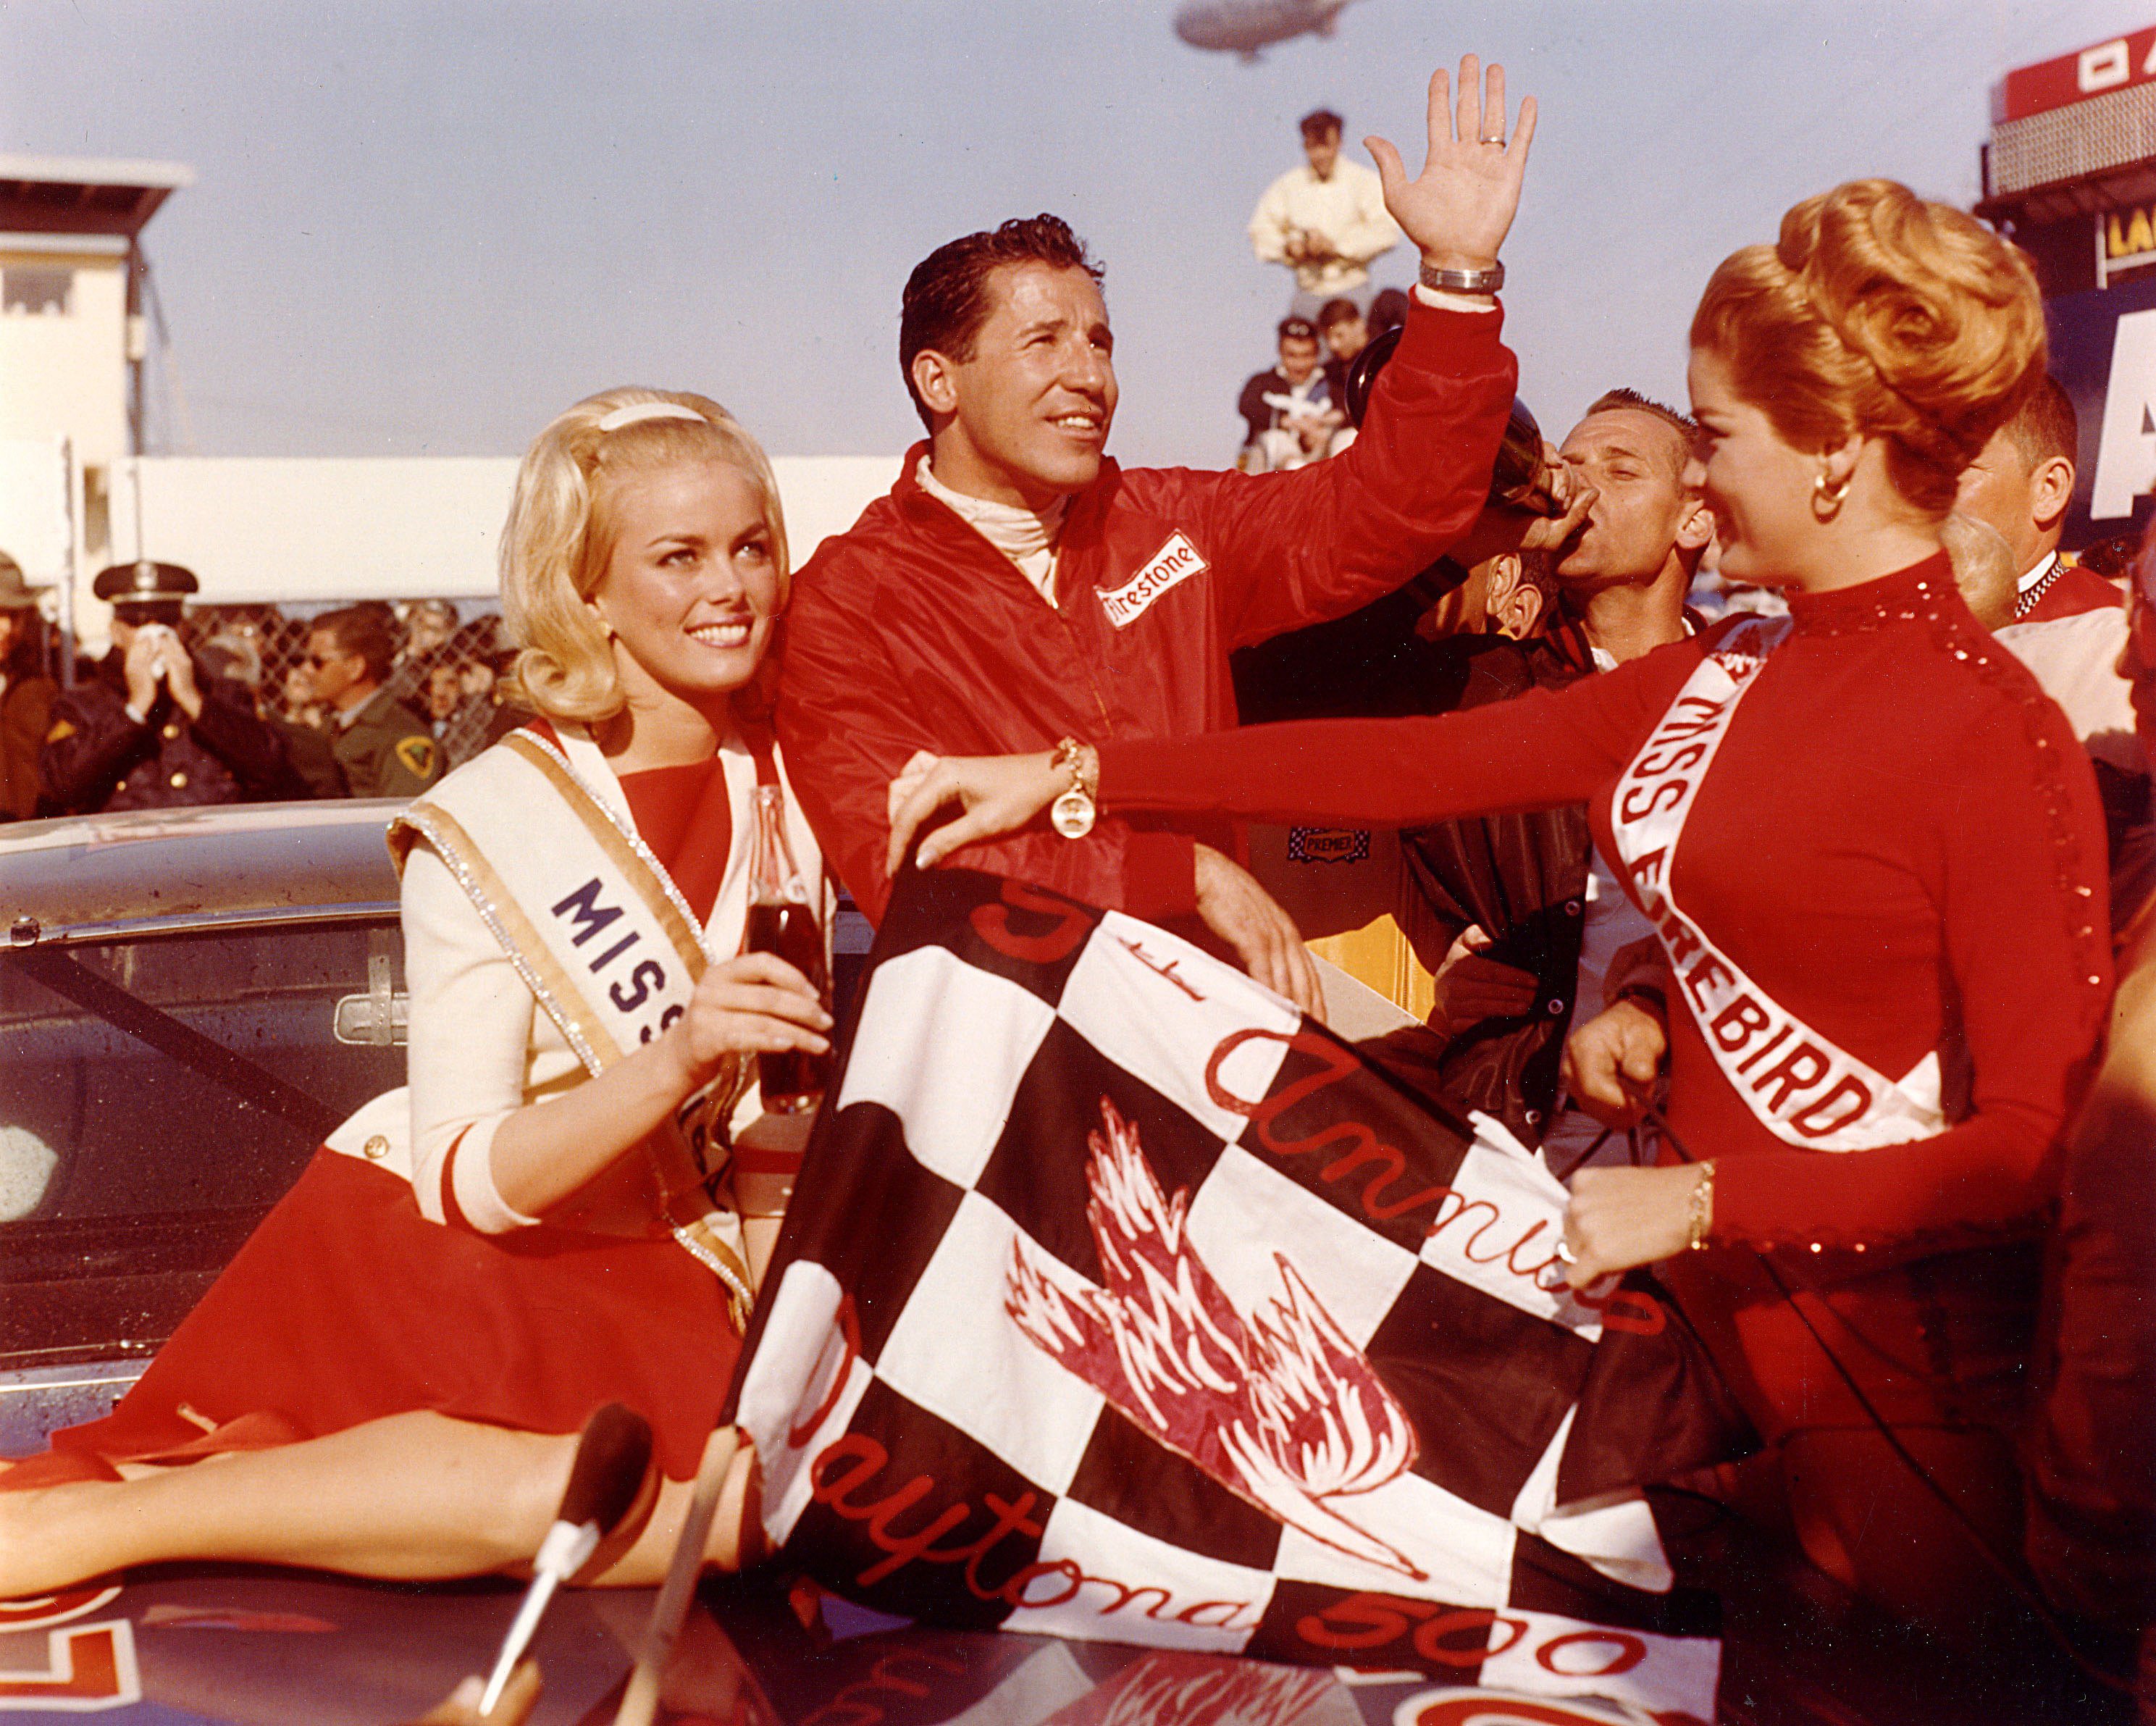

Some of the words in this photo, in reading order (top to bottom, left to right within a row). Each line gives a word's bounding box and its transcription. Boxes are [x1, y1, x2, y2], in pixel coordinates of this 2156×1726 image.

[1102, 547, 1194, 621] Firestone
[1622, 695, 1725, 827] MISS
[1306, 836, 1352, 852] PREMIER
[1296, 1591, 1646, 1675] 500
